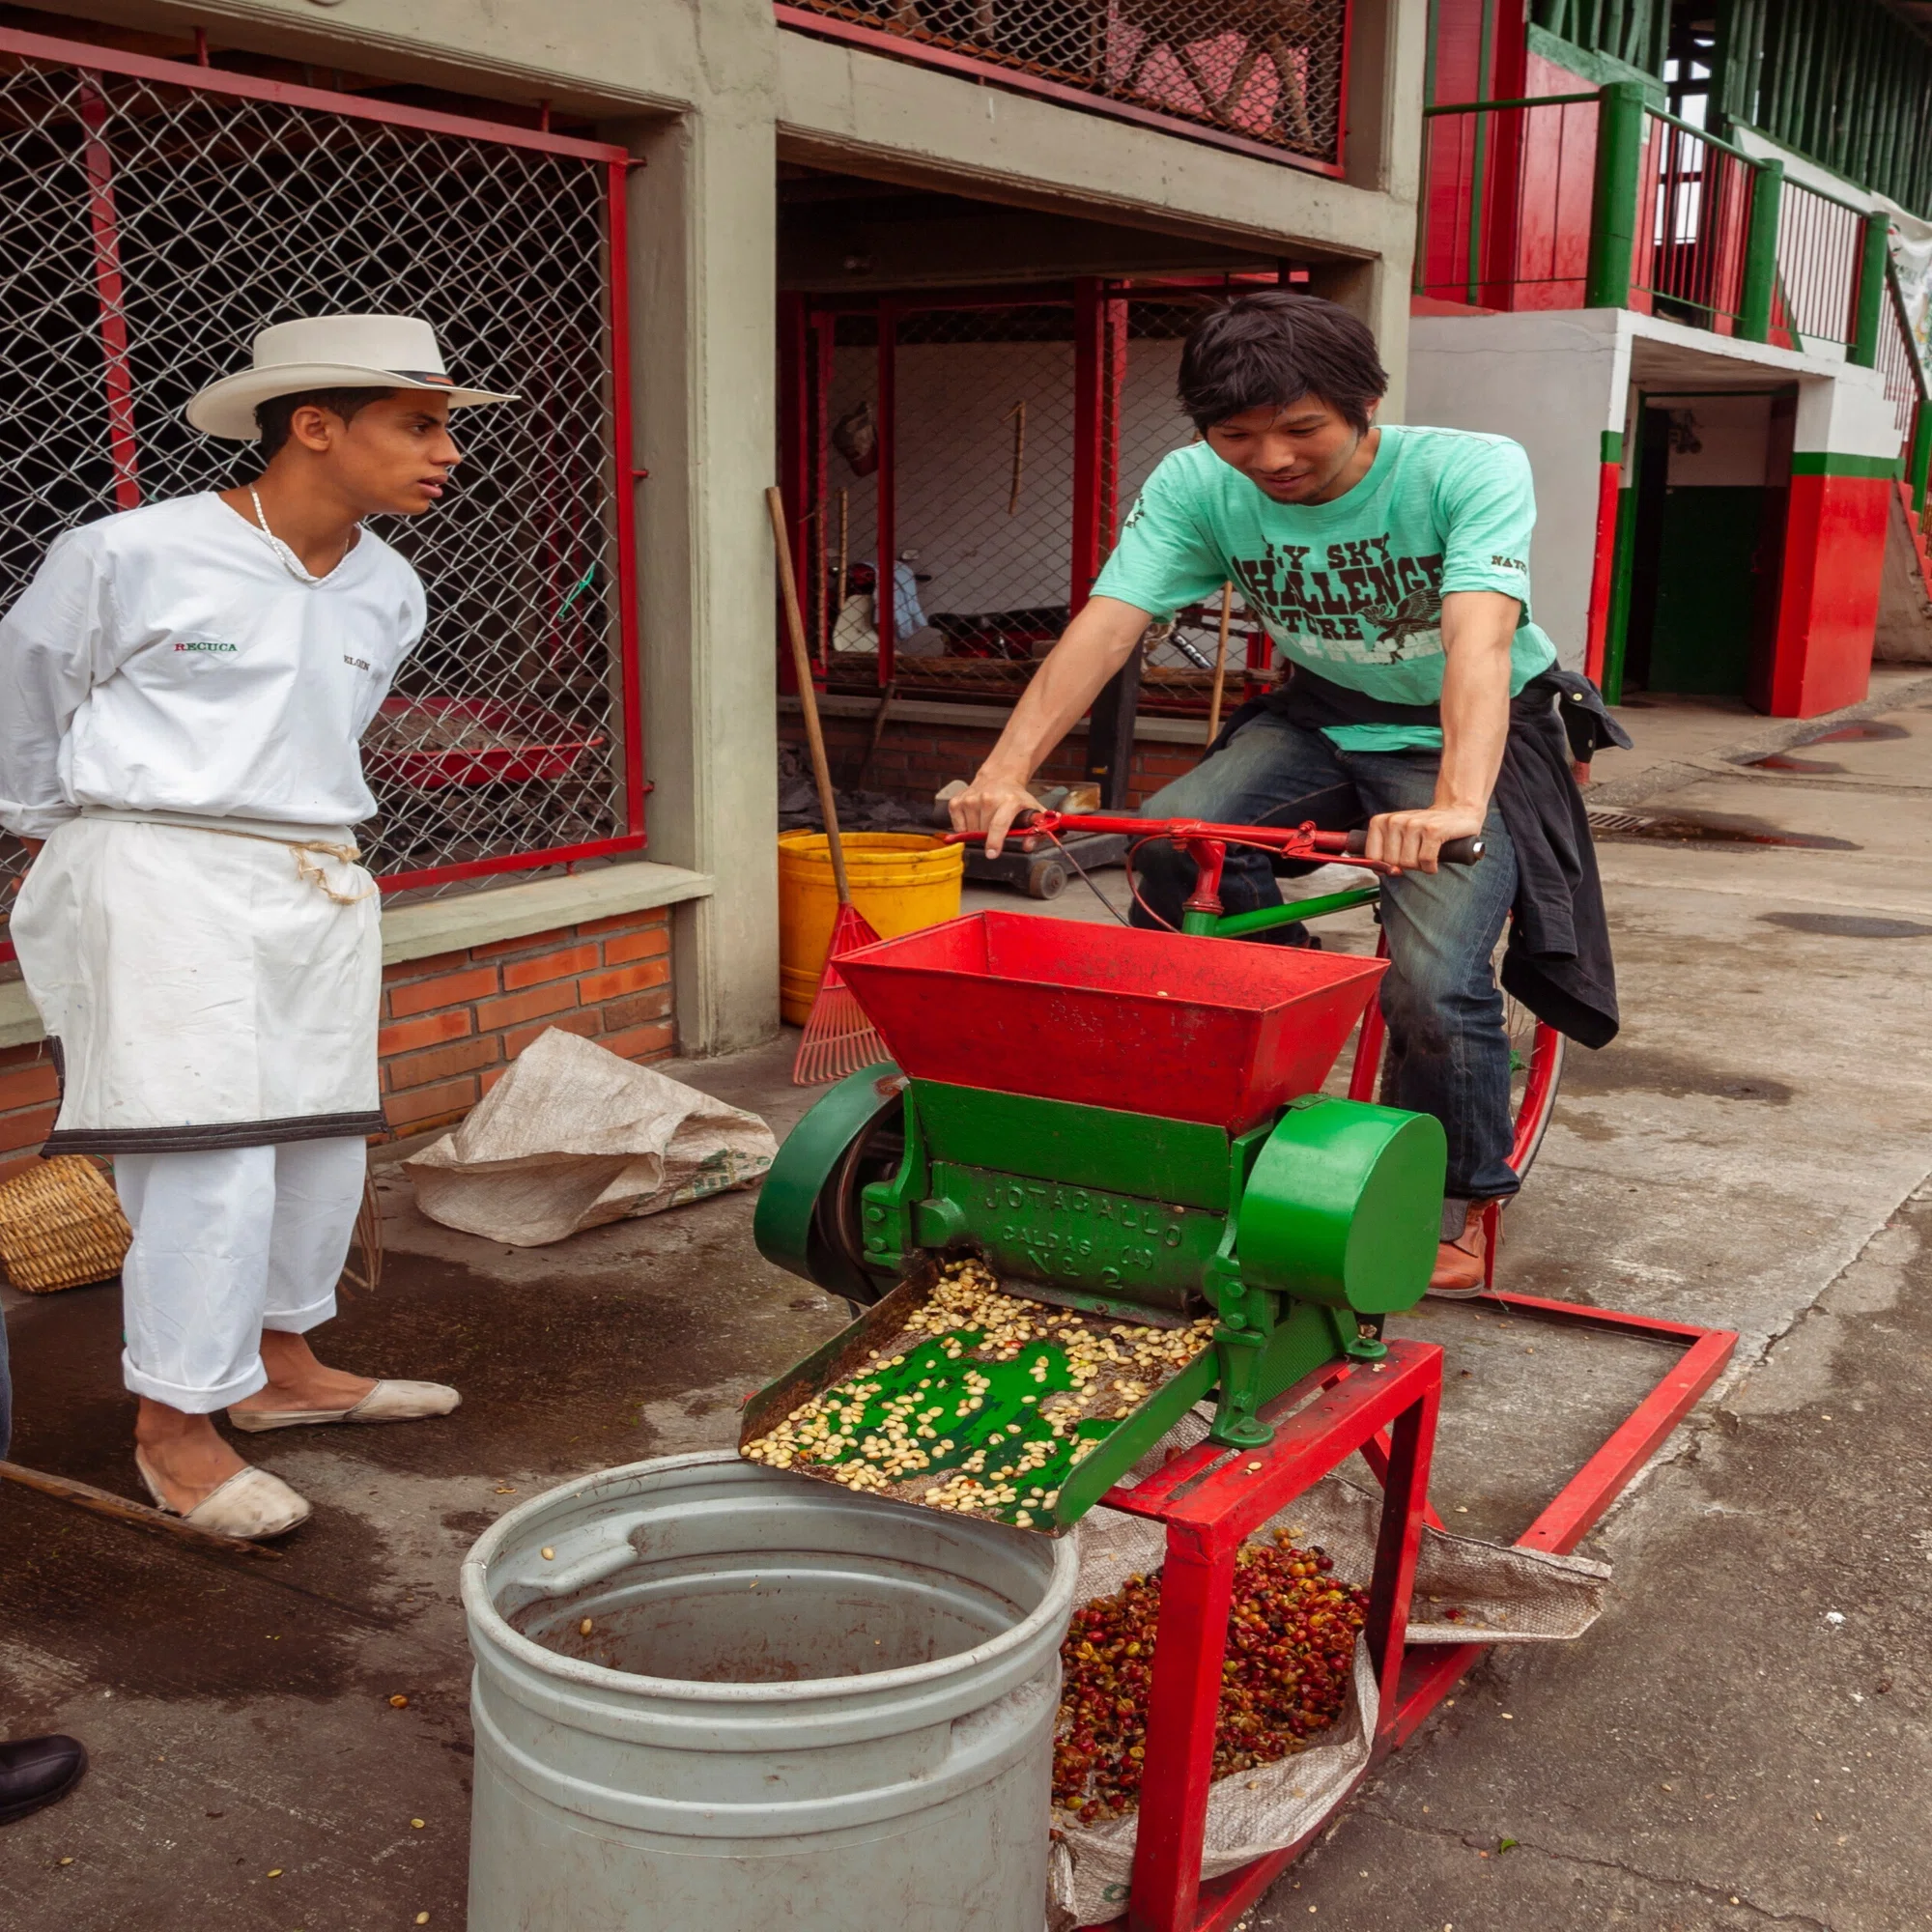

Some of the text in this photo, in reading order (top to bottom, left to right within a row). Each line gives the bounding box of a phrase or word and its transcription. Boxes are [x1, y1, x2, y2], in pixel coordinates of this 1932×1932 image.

[1327, 532, 1390, 570] SKY
[174, 641, 238, 652] RECUCA
[986, 1185, 1181, 1246] JOTAGALLO
[1100, 1265, 1123, 1291] 2
